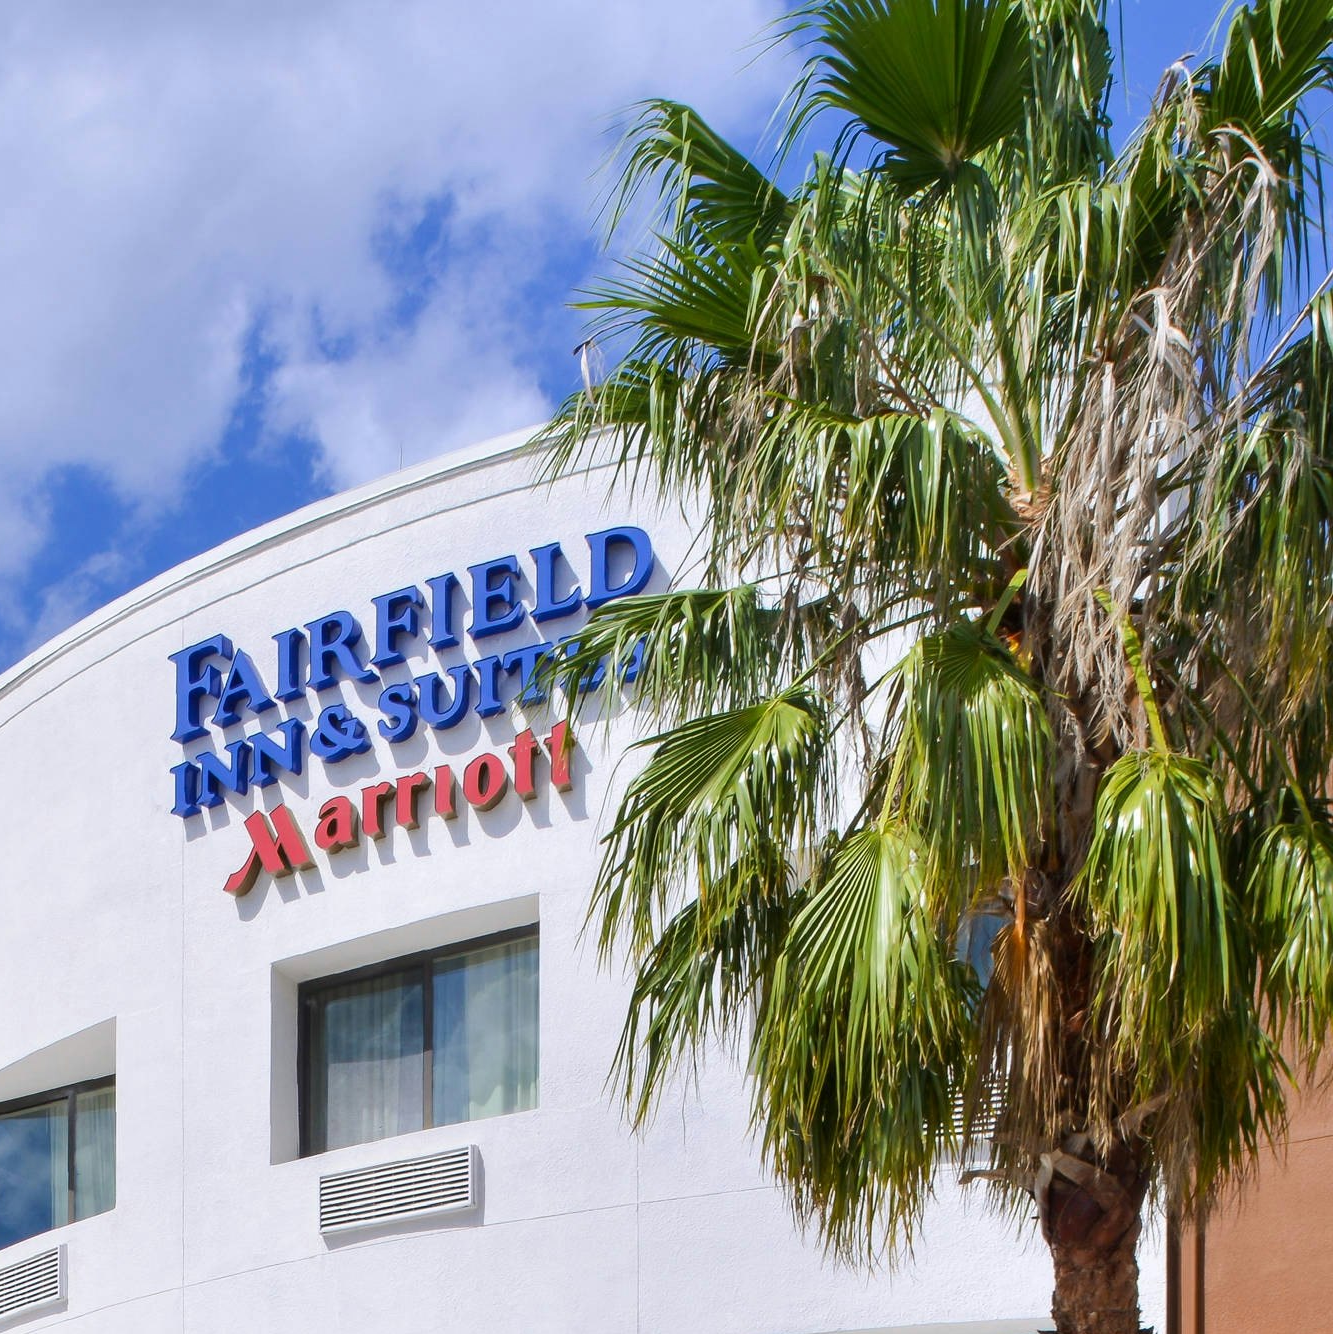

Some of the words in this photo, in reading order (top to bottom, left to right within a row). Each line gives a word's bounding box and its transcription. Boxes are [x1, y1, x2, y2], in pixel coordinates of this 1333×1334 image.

[168, 525, 655, 744] FAIRFIELD
[170, 716, 305, 819] INN
[309, 702, 372, 764] &
[223, 719, 575, 897] Marriott
